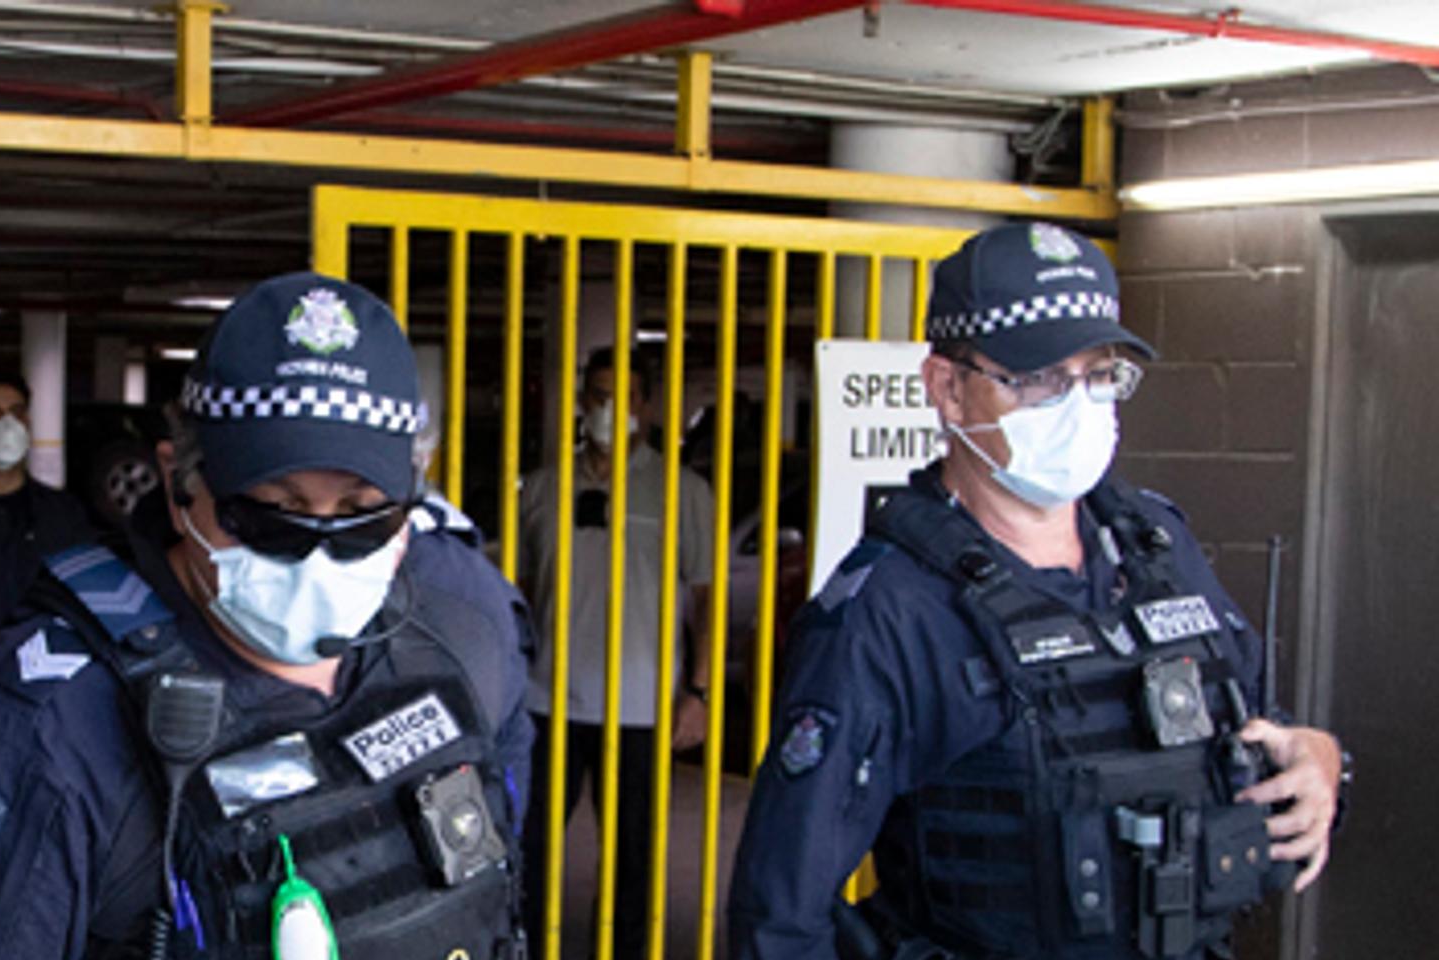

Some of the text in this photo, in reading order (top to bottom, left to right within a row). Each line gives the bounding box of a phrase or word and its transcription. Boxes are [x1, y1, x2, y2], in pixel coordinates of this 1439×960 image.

[843, 373, 934, 407] SPEE
[850, 426, 934, 459] LIMIT
[352, 703, 439, 757] Police
